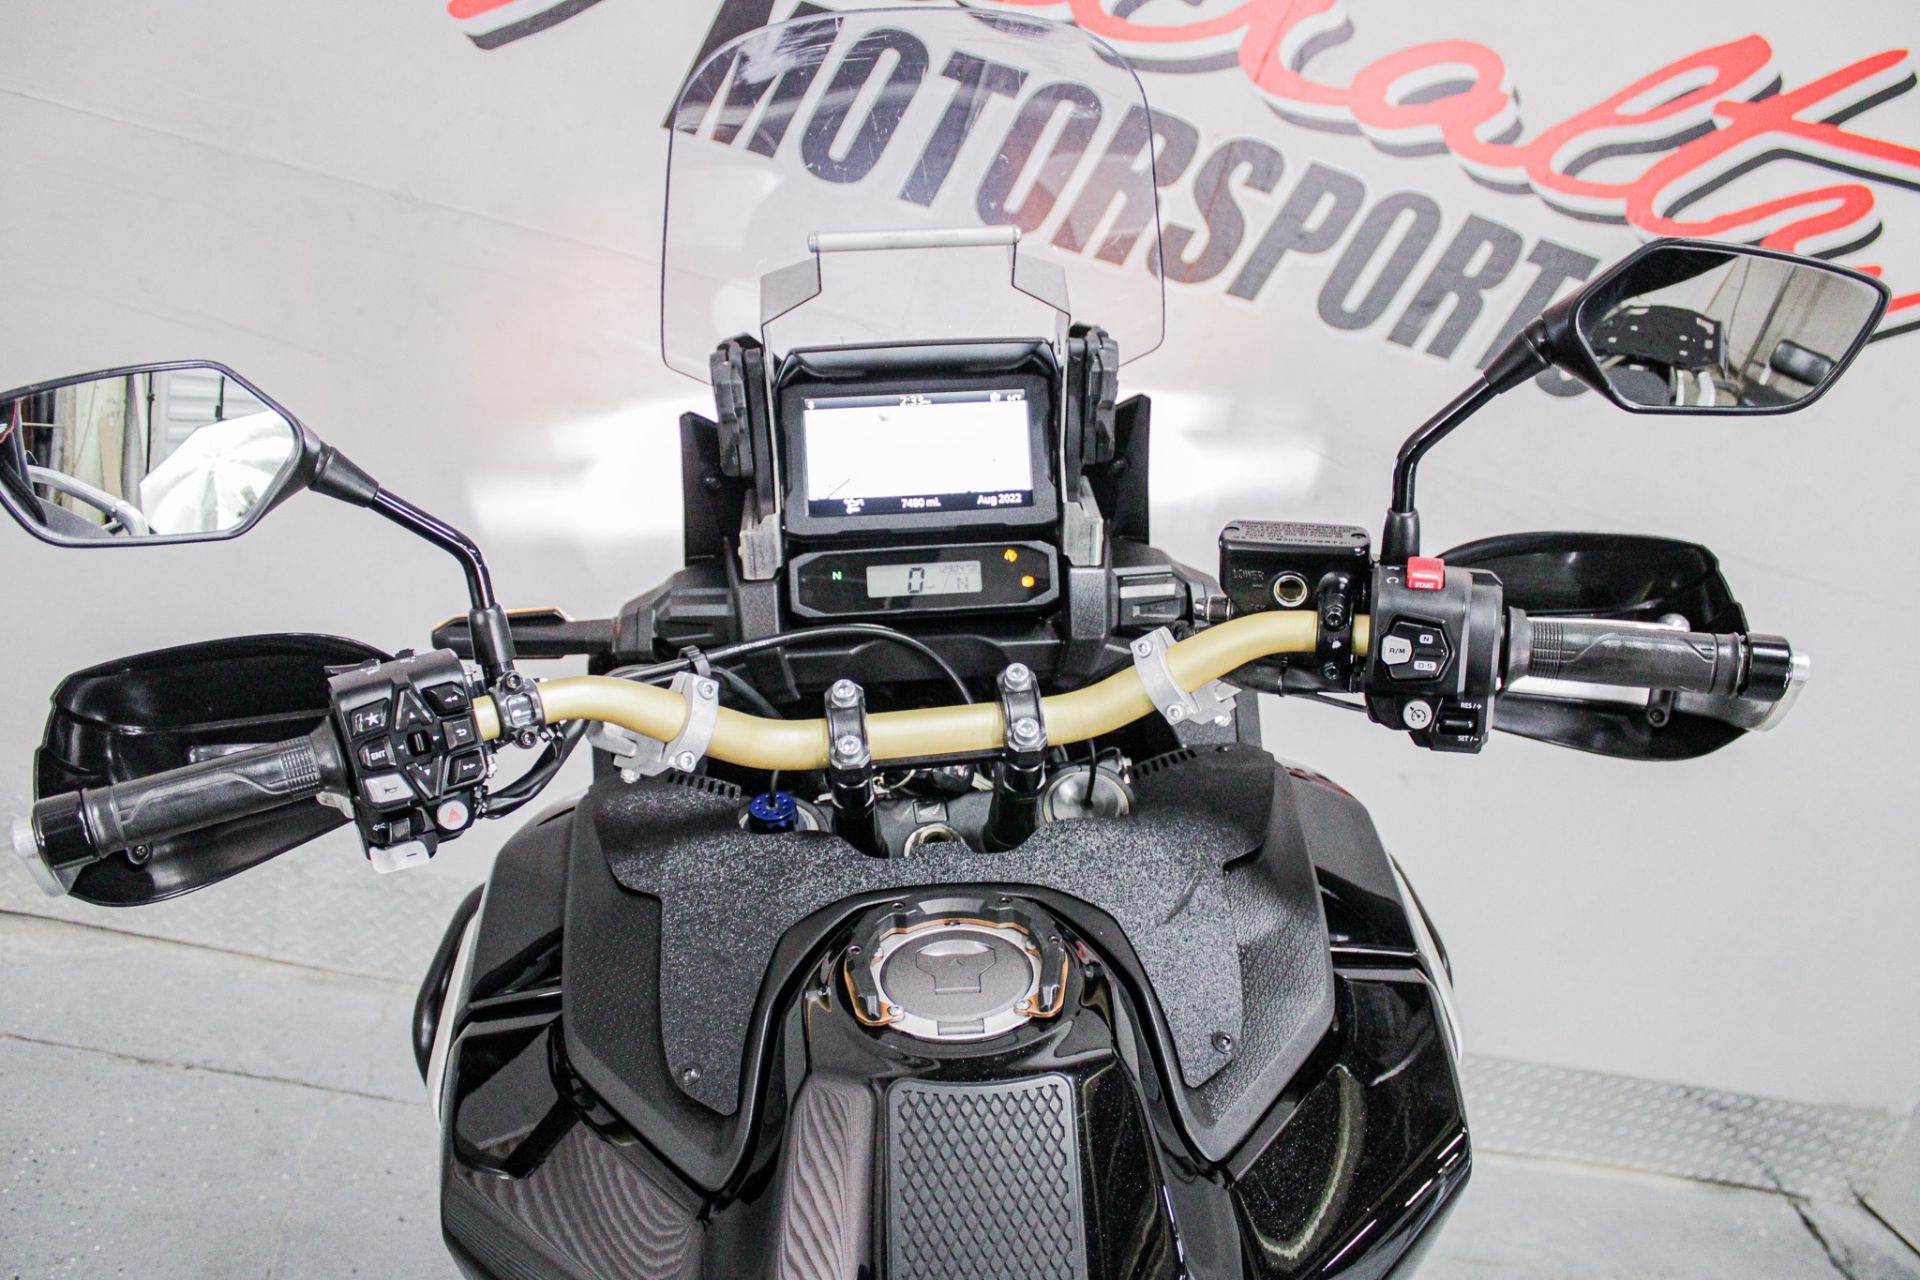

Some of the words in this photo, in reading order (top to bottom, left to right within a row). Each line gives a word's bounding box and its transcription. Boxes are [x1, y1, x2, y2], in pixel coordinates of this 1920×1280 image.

[977, 494, 997, 506] Aug
[998, 493, 1022, 504] 2022
[832, 571, 842, 581] N
[908, 567, 924, 593] 0
[370, 750, 386, 760] ENT
